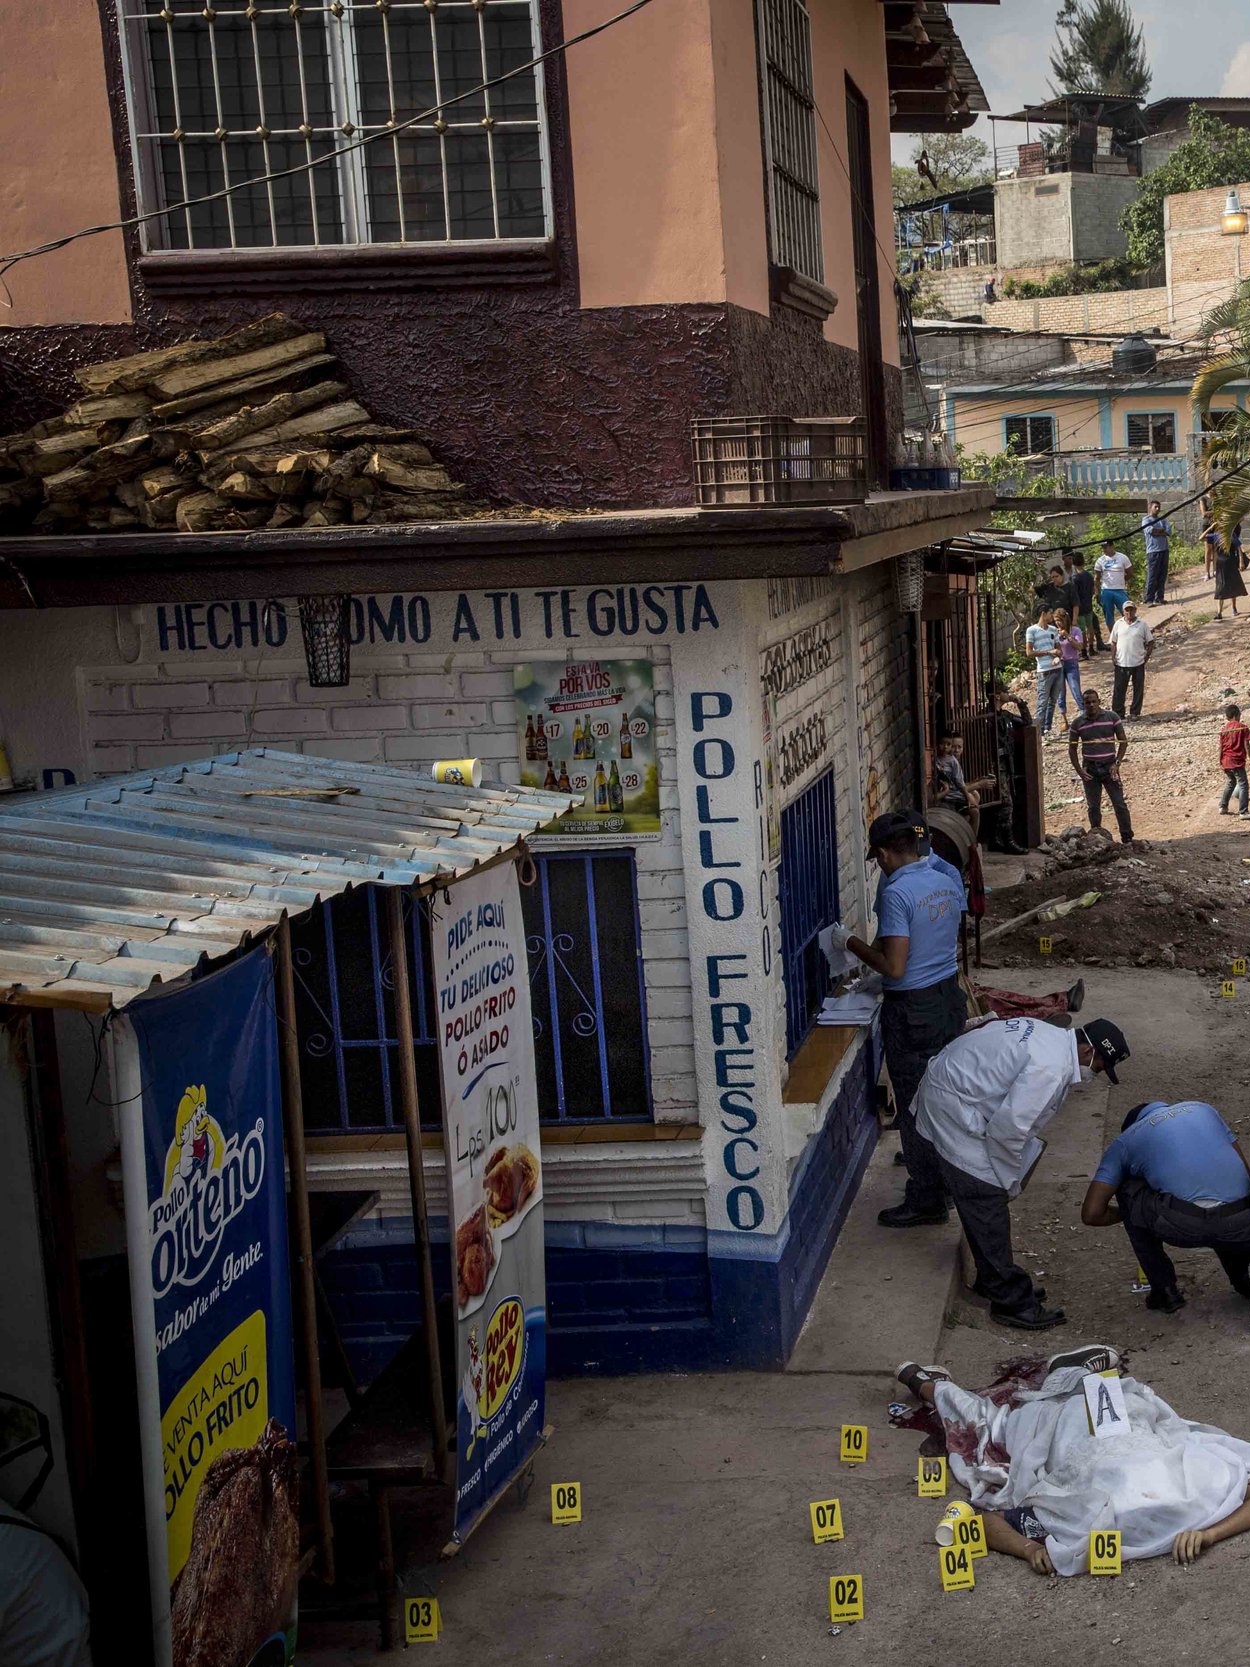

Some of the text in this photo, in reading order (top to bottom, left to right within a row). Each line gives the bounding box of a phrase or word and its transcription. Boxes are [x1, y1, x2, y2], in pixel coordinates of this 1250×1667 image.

[157, 598, 288, 650] HECHO
[340, 595, 431, 644] OMO
[452, 593, 480, 642] A
[484, 591, 521, 639] TI
[587, 583, 719, 637] GUSTA
[560, 672, 611, 695] POR VOS
[566, 661, 600, 677] ESTA VA
[691, 691, 744, 921] POLLO
[913, 825, 925, 834] CIA
[753, 760, 771, 976] RICO
[447, 900, 505, 960] PIDE AQUÍ
[1042, 939, 1050, 948] 15
[1235, 961, 1243, 970] 16
[440, 953, 514, 1013] TU DELICIOSO
[1224, 983, 1233, 992] 14
[445, 986, 516, 1047] POLLO FRITO
[457, 1024, 509, 1076] Ó ASADO
[1101, 1038, 1116, 1056] DPI
[706, 954, 764, 1231] FRESCO
[152, 1132, 262, 1293] orteño
[153, 1186, 185, 1236] Pollo
[199, 1295, 209, 1316] de
[209, 1280, 220, 1301] mi
[486, 1303, 518, 1367] Pollo
[486, 1327, 519, 1415] Rey
[167, 1387, 210, 1454] VENTA
[212, 1344, 248, 1397] AQUÍ
[1096, 1381, 1121, 1427] A
[165, 1377, 259, 1522] OLLO FRITO
[844, 1429, 862, 1450] 10
[460, 1468, 482, 1499] FRESCO
[922, 1460, 942, 1483] 09
[556, 1486, 577, 1510] 08
[815, 1504, 836, 1528] 07
[958, 1519, 980, 1544] 06
[945, 1548, 968, 1575] 04
[1095, 1534, 1117, 1558] 05
[834, 1579, 858, 1605] 02
[410, 1602, 432, 1627] 03
